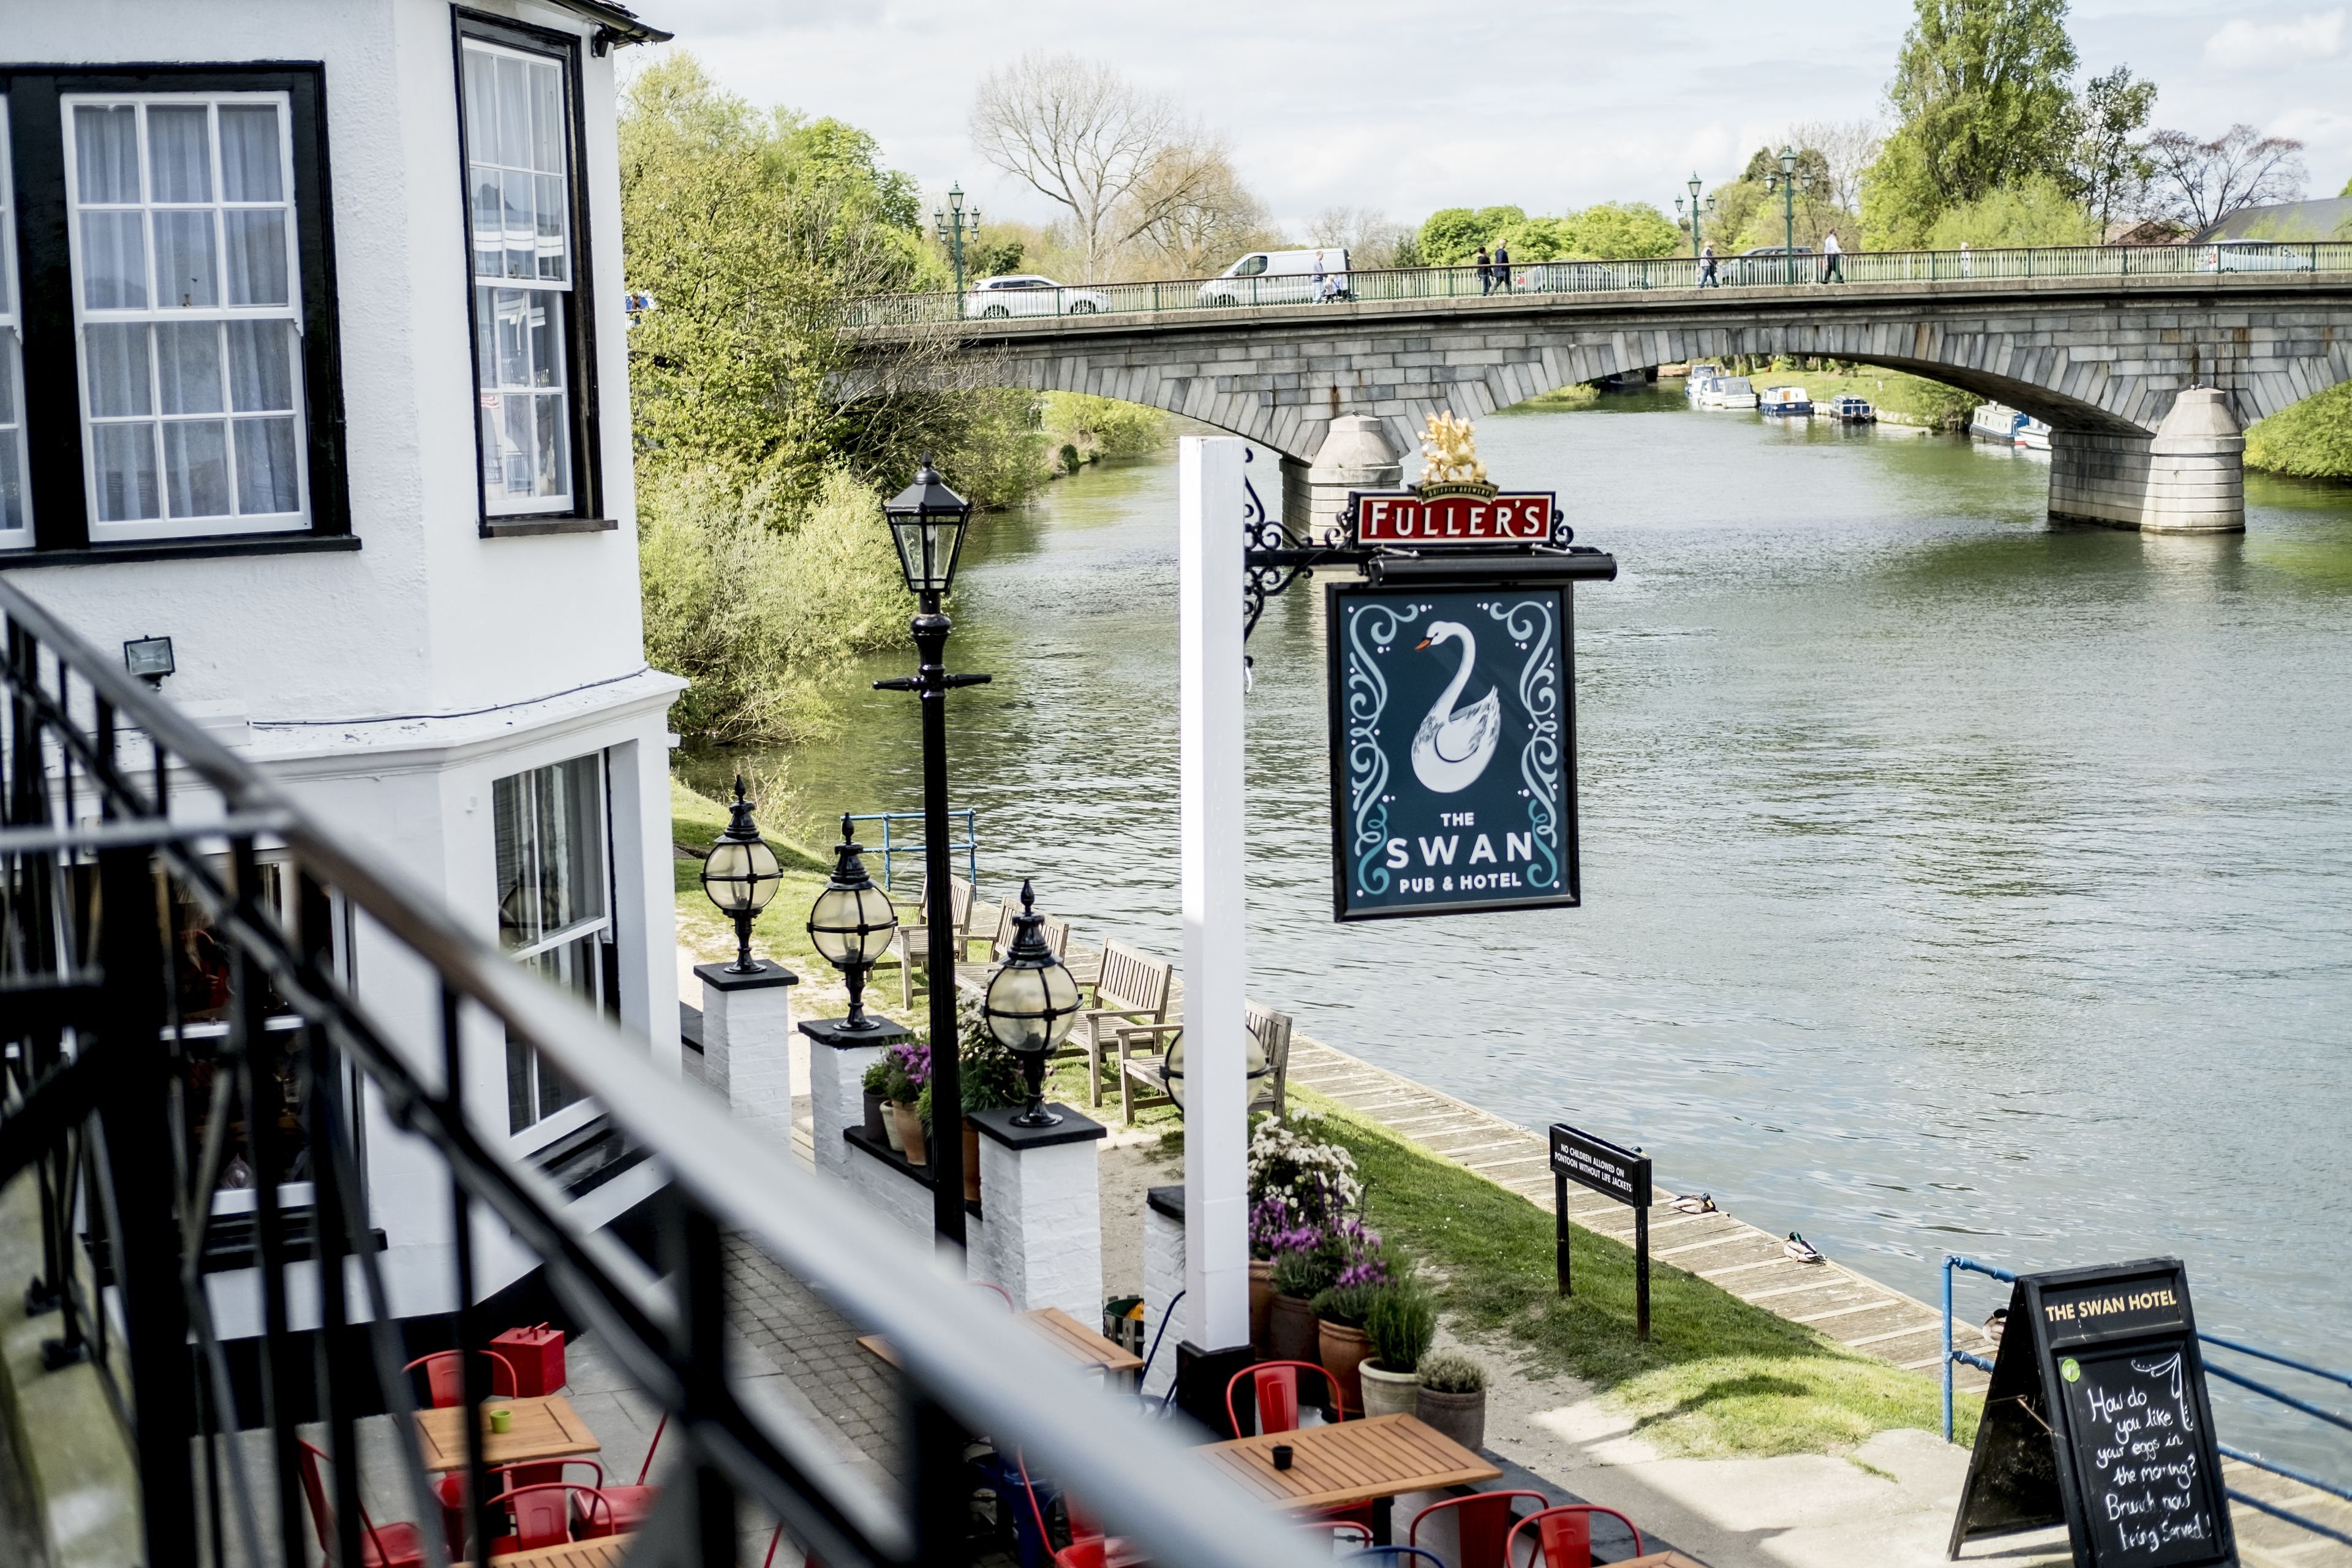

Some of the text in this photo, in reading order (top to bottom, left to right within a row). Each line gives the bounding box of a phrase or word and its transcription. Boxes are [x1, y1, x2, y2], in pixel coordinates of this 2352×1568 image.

[1370, 500, 1540, 538] FULLER'S
[1440, 812, 1475, 827] THE
[1385, 832, 1532, 869] SWAN
[1400, 872, 1522, 894] PUB & HOTEL
[1555, 1152, 1632, 1193] PONTOON WITHOUT LIFE JACKETS
[1570, 1147, 1592, 1164] CHILDREN
[1593, 1156, 1615, 1174] ALLOWED
[1616, 1167, 1624, 1178] ON
[2046, 1290, 2177, 1322] THE SWAN HOTEL
[2087, 1386, 2147, 1423] How do
[2116, 1409, 2173, 1444] you like
[2097, 1433, 2183, 1468] your eggs in
[2113, 1464, 2136, 1486] the
[2162, 1491, 2190, 1511] now
